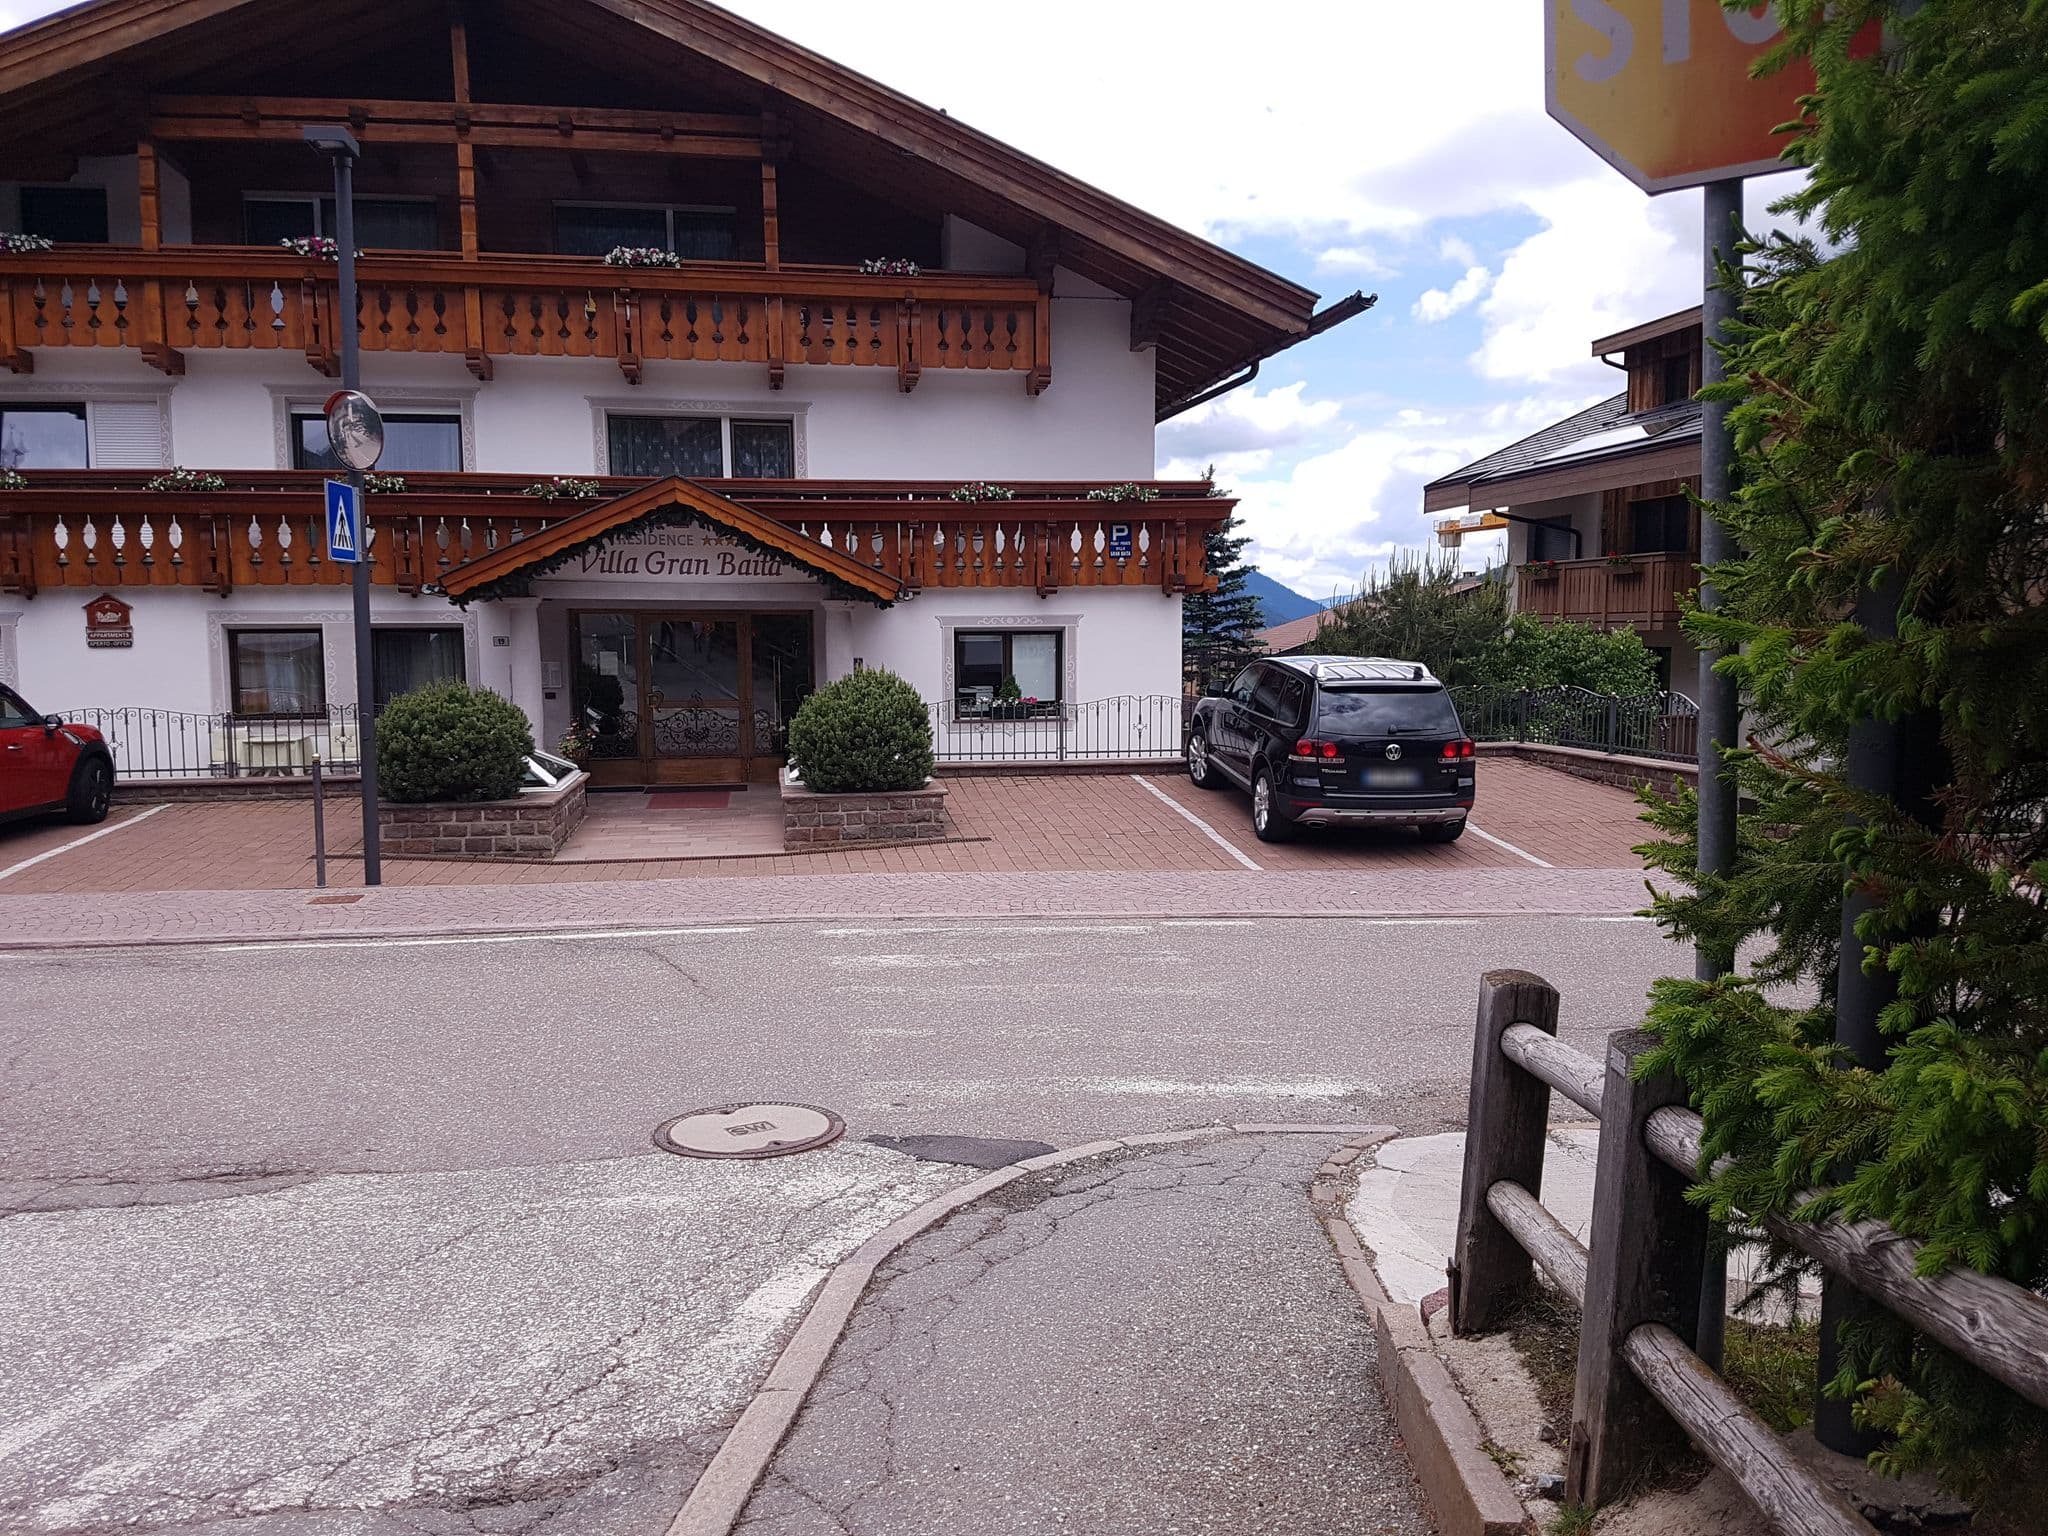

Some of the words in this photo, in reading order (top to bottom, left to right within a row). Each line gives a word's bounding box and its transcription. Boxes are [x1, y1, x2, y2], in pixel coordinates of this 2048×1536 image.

[618, 534, 694, 546] RESIDENCE
[1113, 525, 1129, 541] P
[581, 550, 639, 574] Villa
[645, 550, 710, 575] Gran
[716, 552, 783, 576] Baita
